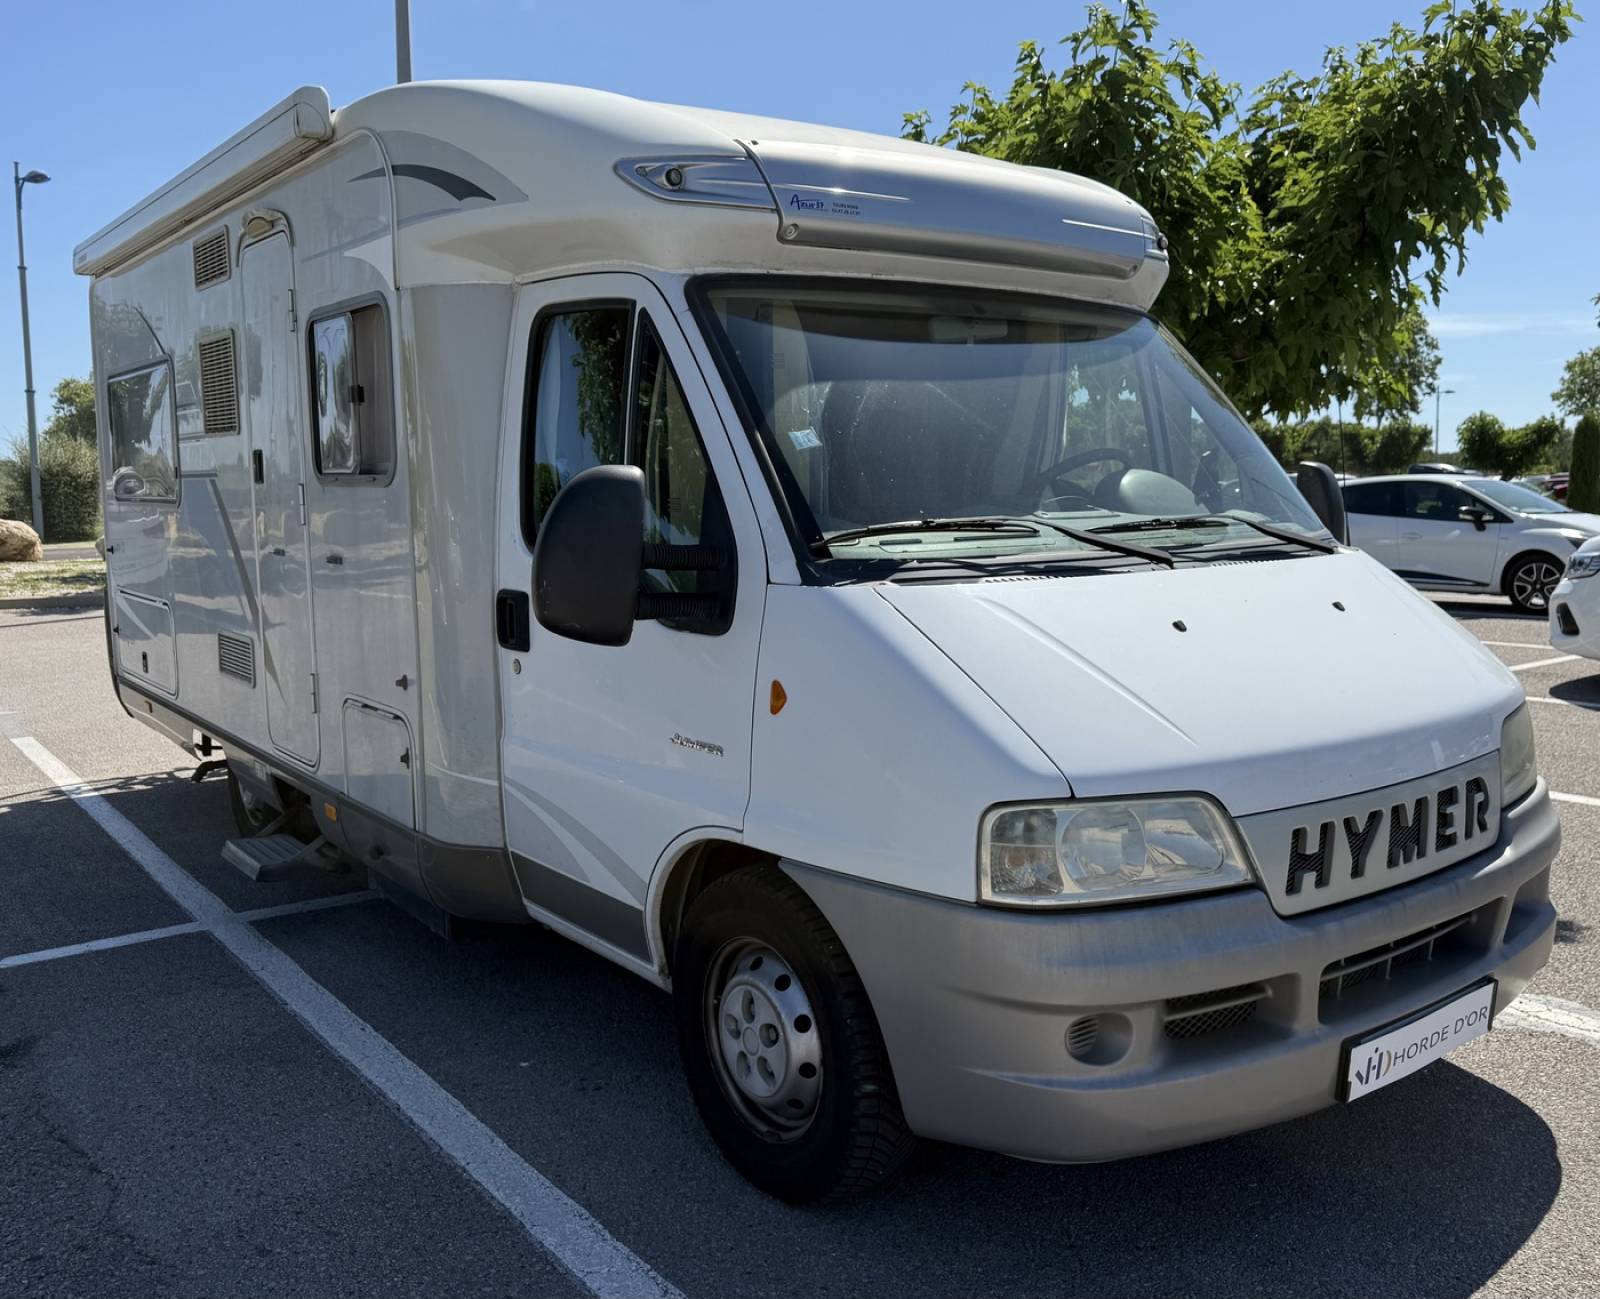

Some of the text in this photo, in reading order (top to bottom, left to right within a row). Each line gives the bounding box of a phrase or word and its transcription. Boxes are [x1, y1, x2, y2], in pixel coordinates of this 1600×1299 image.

[1285, 776, 1490, 896] HYMER
[1393, 1025, 1450, 1067] HORDE
[1454, 1006, 1488, 1035] D'OR
